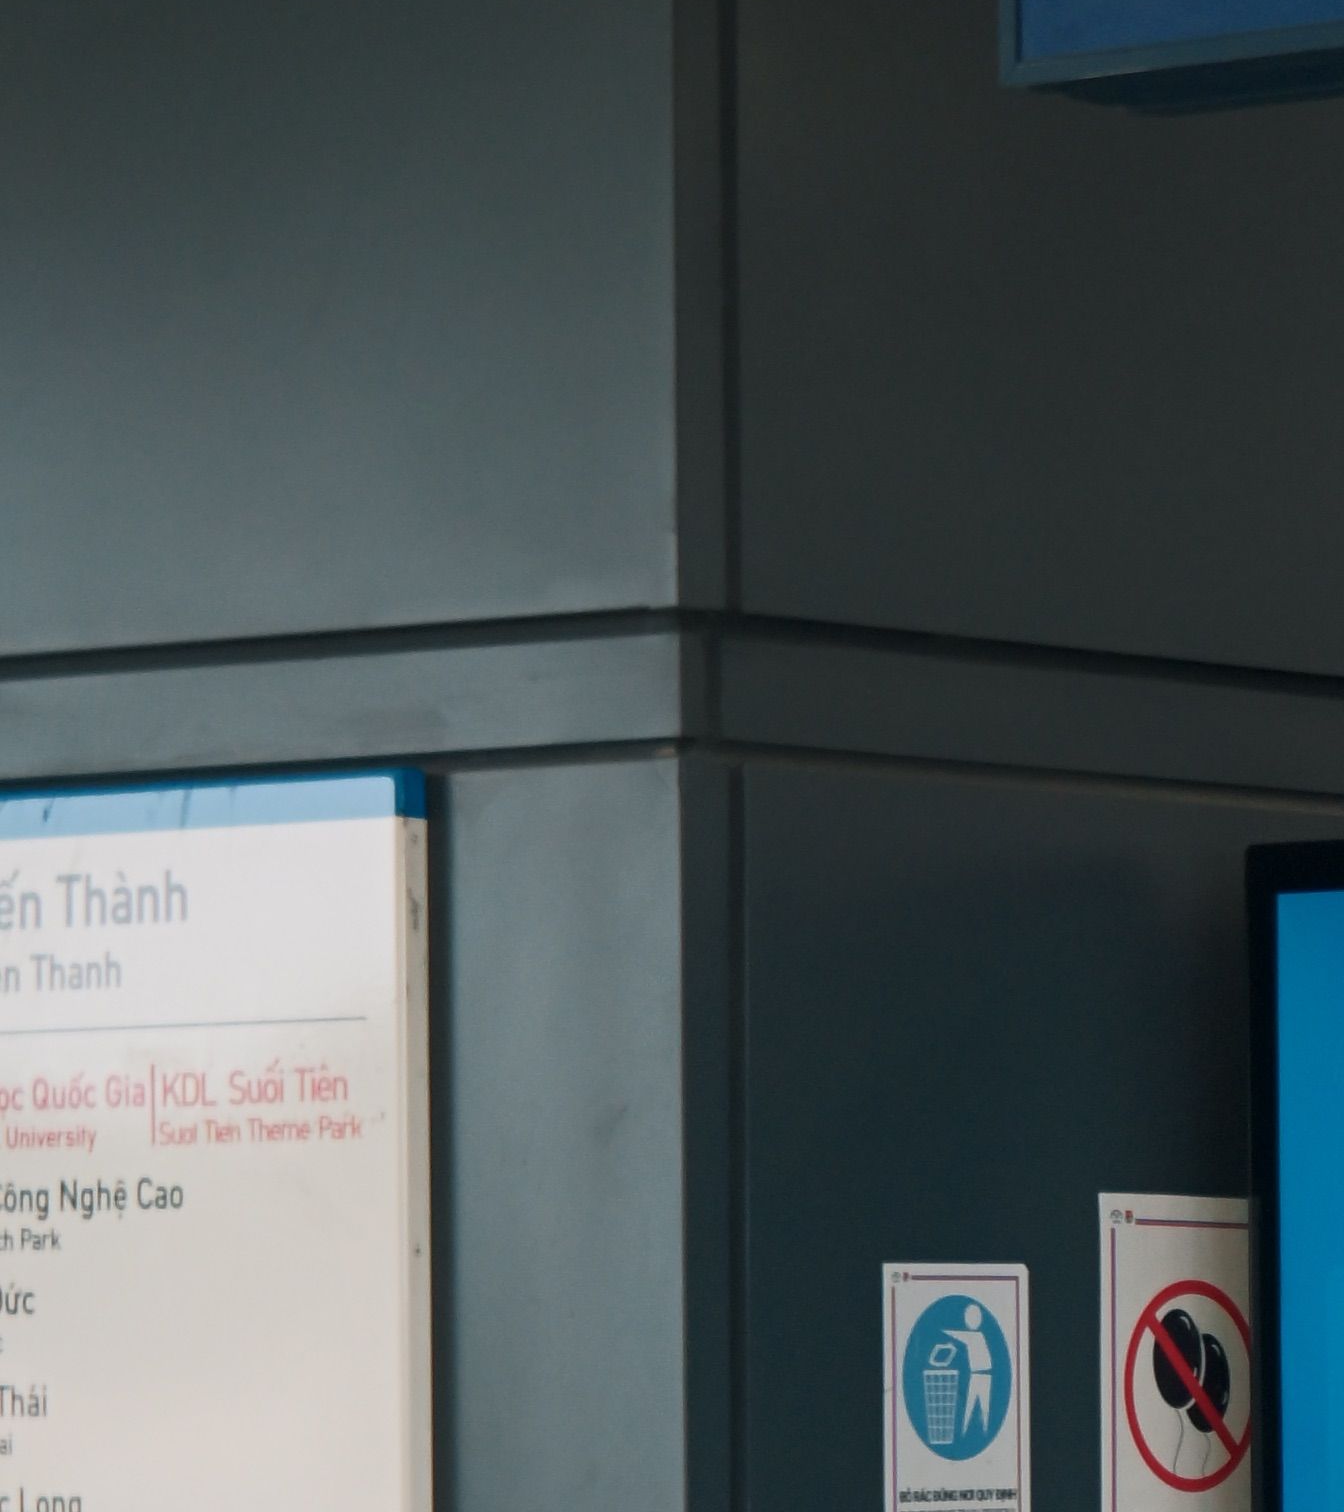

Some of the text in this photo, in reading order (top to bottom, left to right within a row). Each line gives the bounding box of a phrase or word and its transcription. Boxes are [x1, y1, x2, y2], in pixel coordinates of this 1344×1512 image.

[55, 869, 189, 928] Thành
[30, 952, 122, 990] Thanh
[32, 1072, 146, 1111] Quốc Gia
[161, 1071, 217, 1108] KDL
[5, 1125, 97, 1153] University
[318, 1114, 363, 1141] Park
[60, 1178, 128, 1220] Nghệ
[136, 1176, 184, 1210] Cao
[20, 1227, 61, 1251] Park
